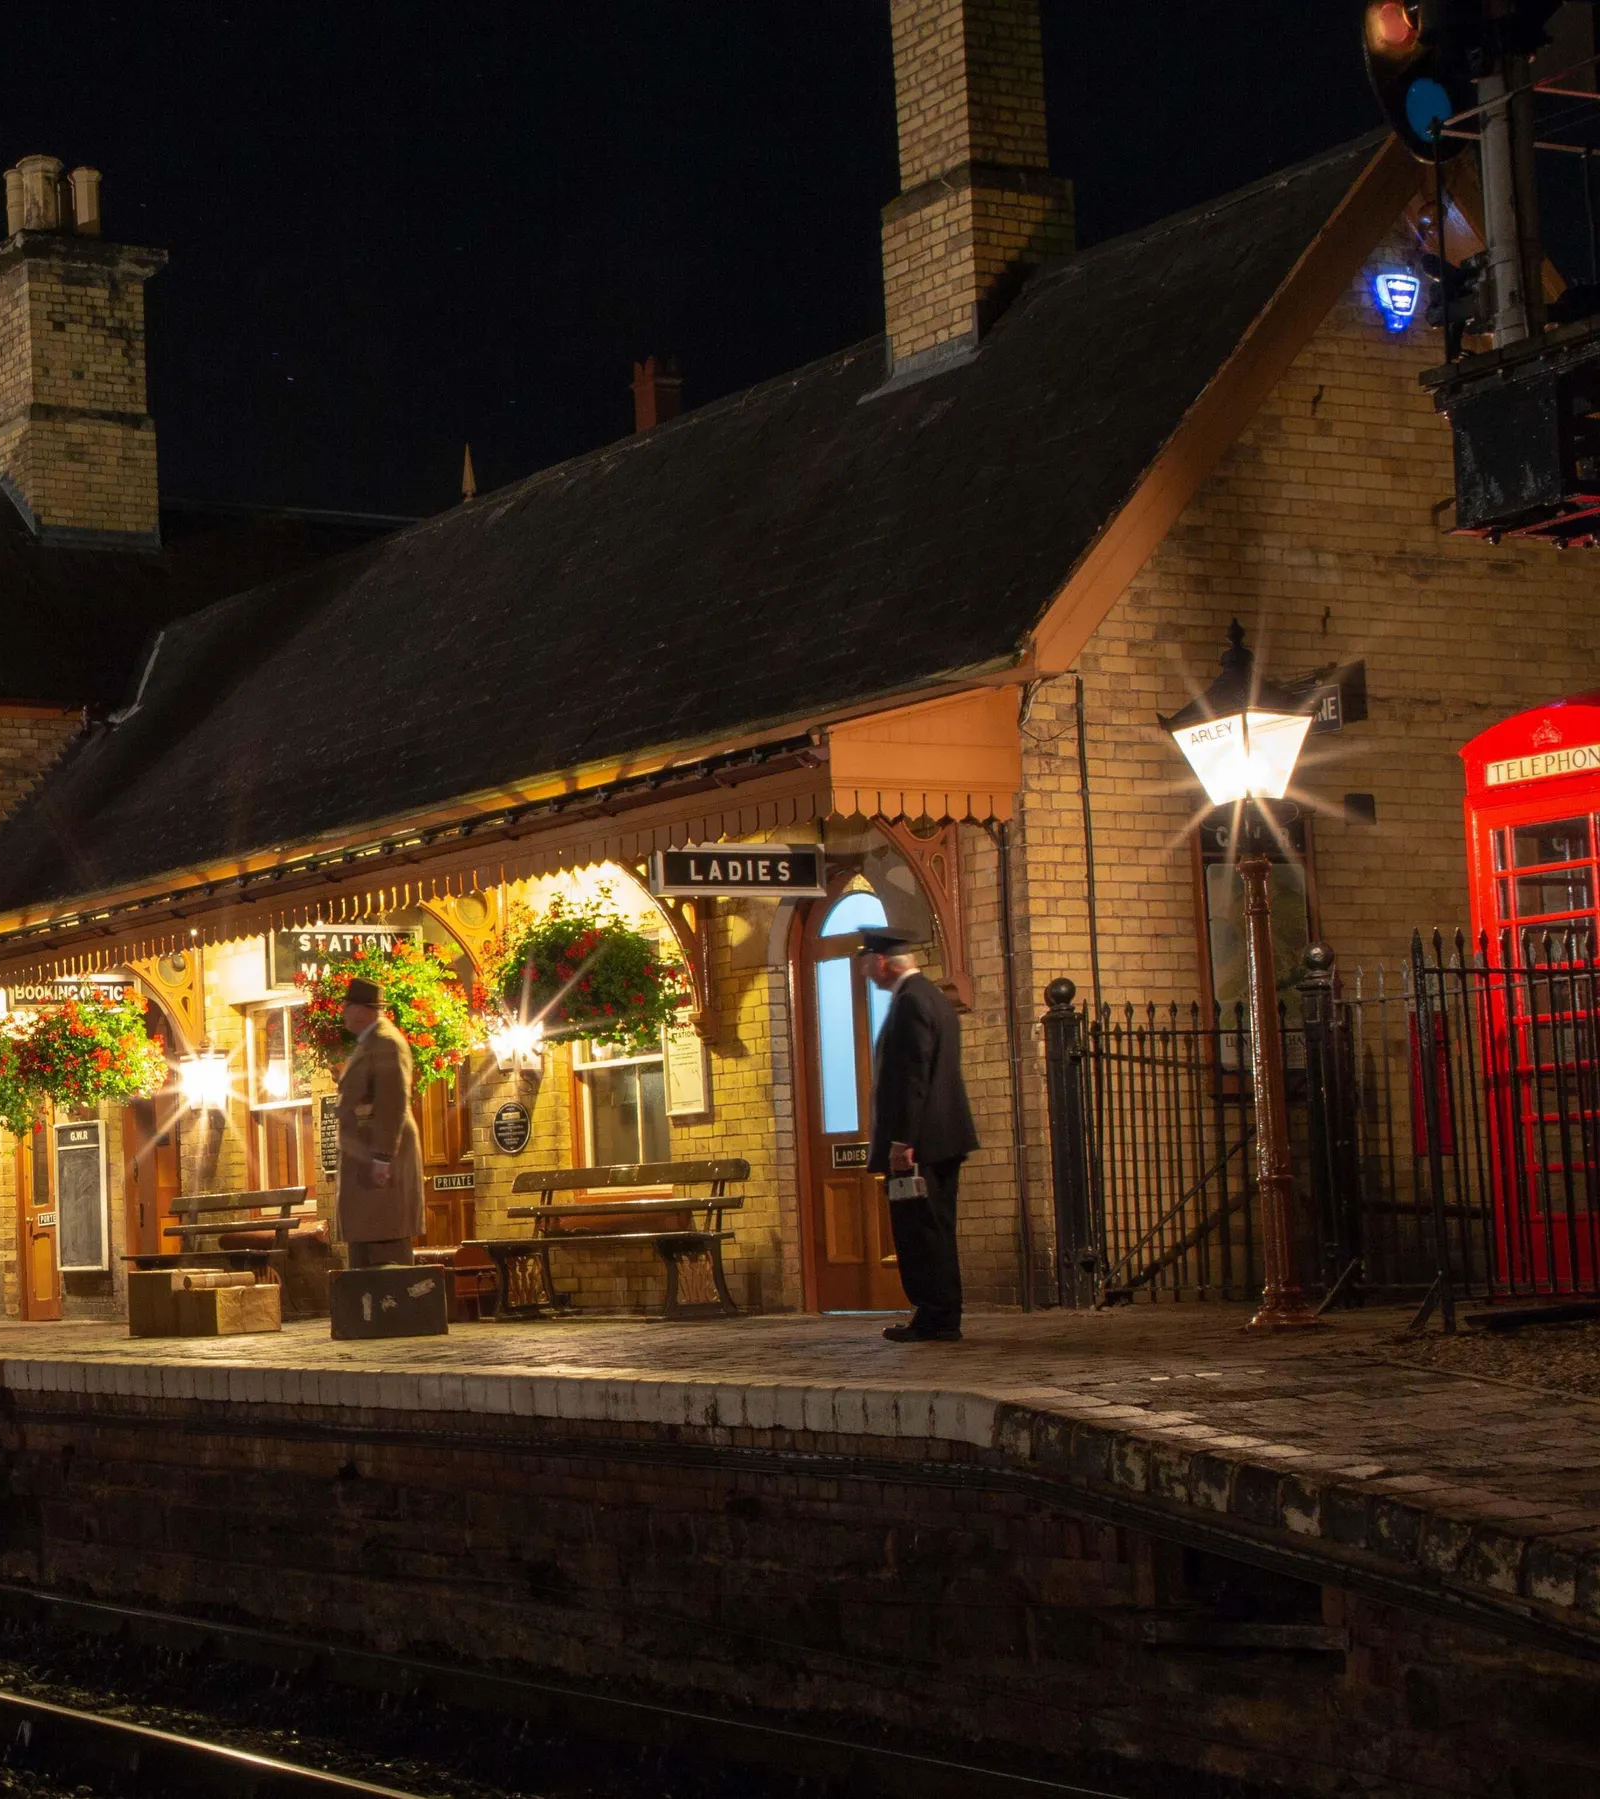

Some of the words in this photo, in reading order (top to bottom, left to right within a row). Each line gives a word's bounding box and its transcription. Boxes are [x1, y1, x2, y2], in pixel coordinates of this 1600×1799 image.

[1313, 697, 1338, 722] NE
[1189, 721, 1233, 745] ARLEY
[690, 860, 791, 882] LADIES
[299, 934, 393, 953] STATION
[15, 984, 79, 1001] BOOKING
[80, 985, 126, 1001] OFFIC
[836, 1149, 867, 1162] LADIES
[437, 1175, 472, 1188] PRIVATE
